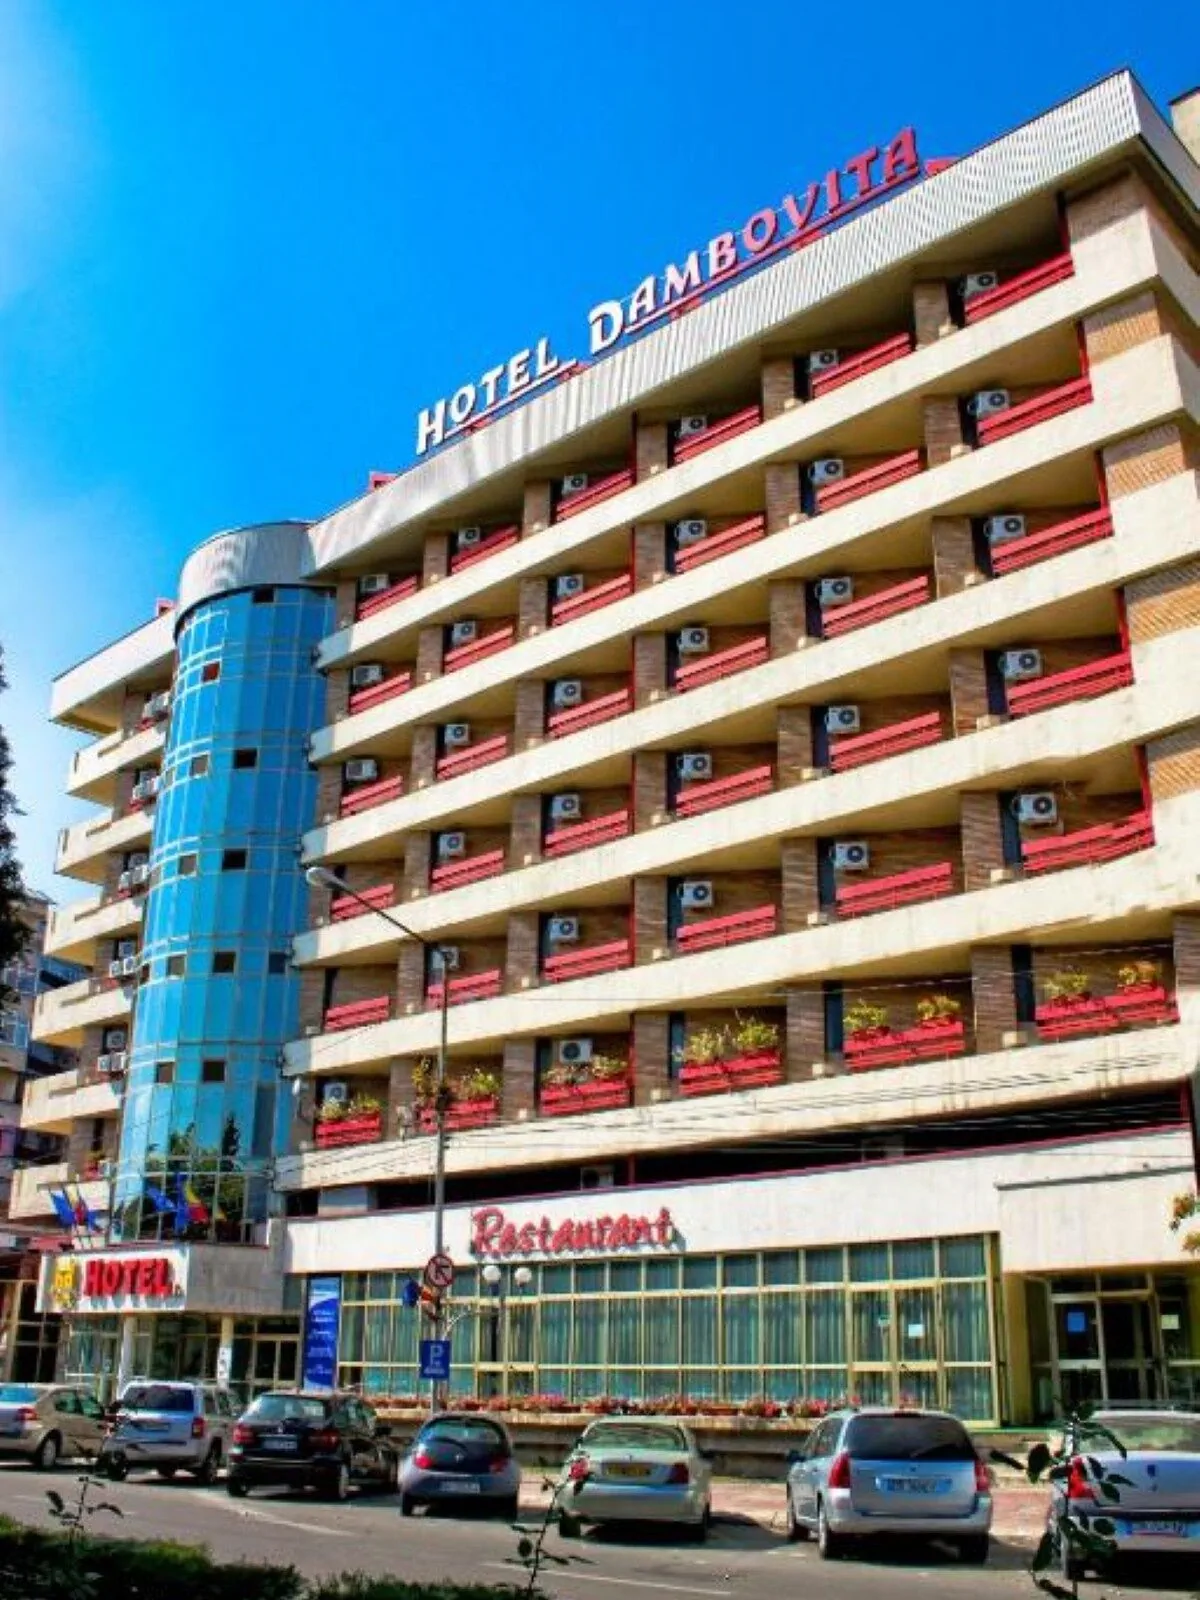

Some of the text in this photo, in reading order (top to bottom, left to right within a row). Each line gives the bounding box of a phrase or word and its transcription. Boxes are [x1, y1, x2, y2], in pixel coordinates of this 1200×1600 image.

[416, 125, 918, 456] HOTEL DAMBOVITA
[471, 1206, 673, 1256] Restaurant
[84, 1258, 174, 1297] HOTEL
[430, 1344, 444, 1366] P
